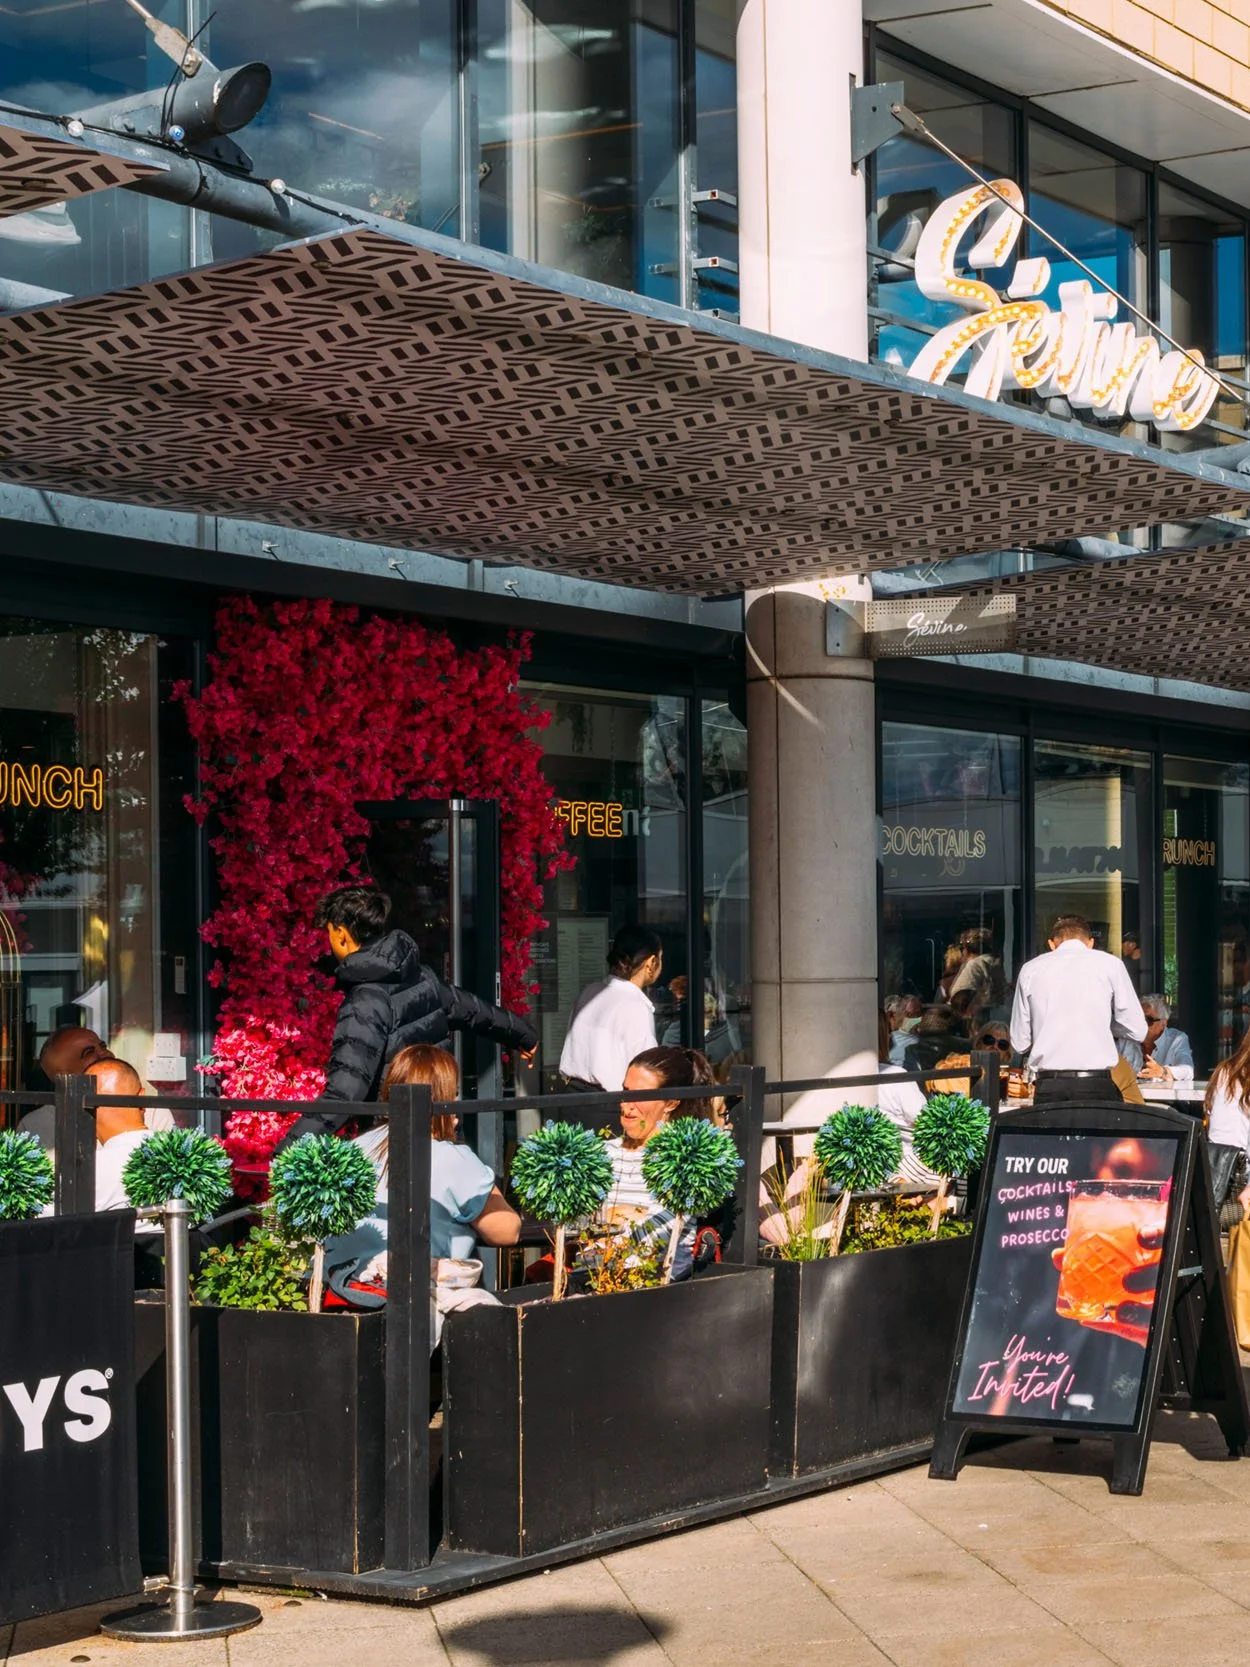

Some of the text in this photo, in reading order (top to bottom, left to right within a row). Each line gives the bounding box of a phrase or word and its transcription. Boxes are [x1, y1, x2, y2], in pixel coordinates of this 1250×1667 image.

[1005, 1156, 1069, 1174] TRY OUR
[1008, 1205, 1065, 1224] WINES &
[1001, 1228, 1070, 1248] PROSECCO
